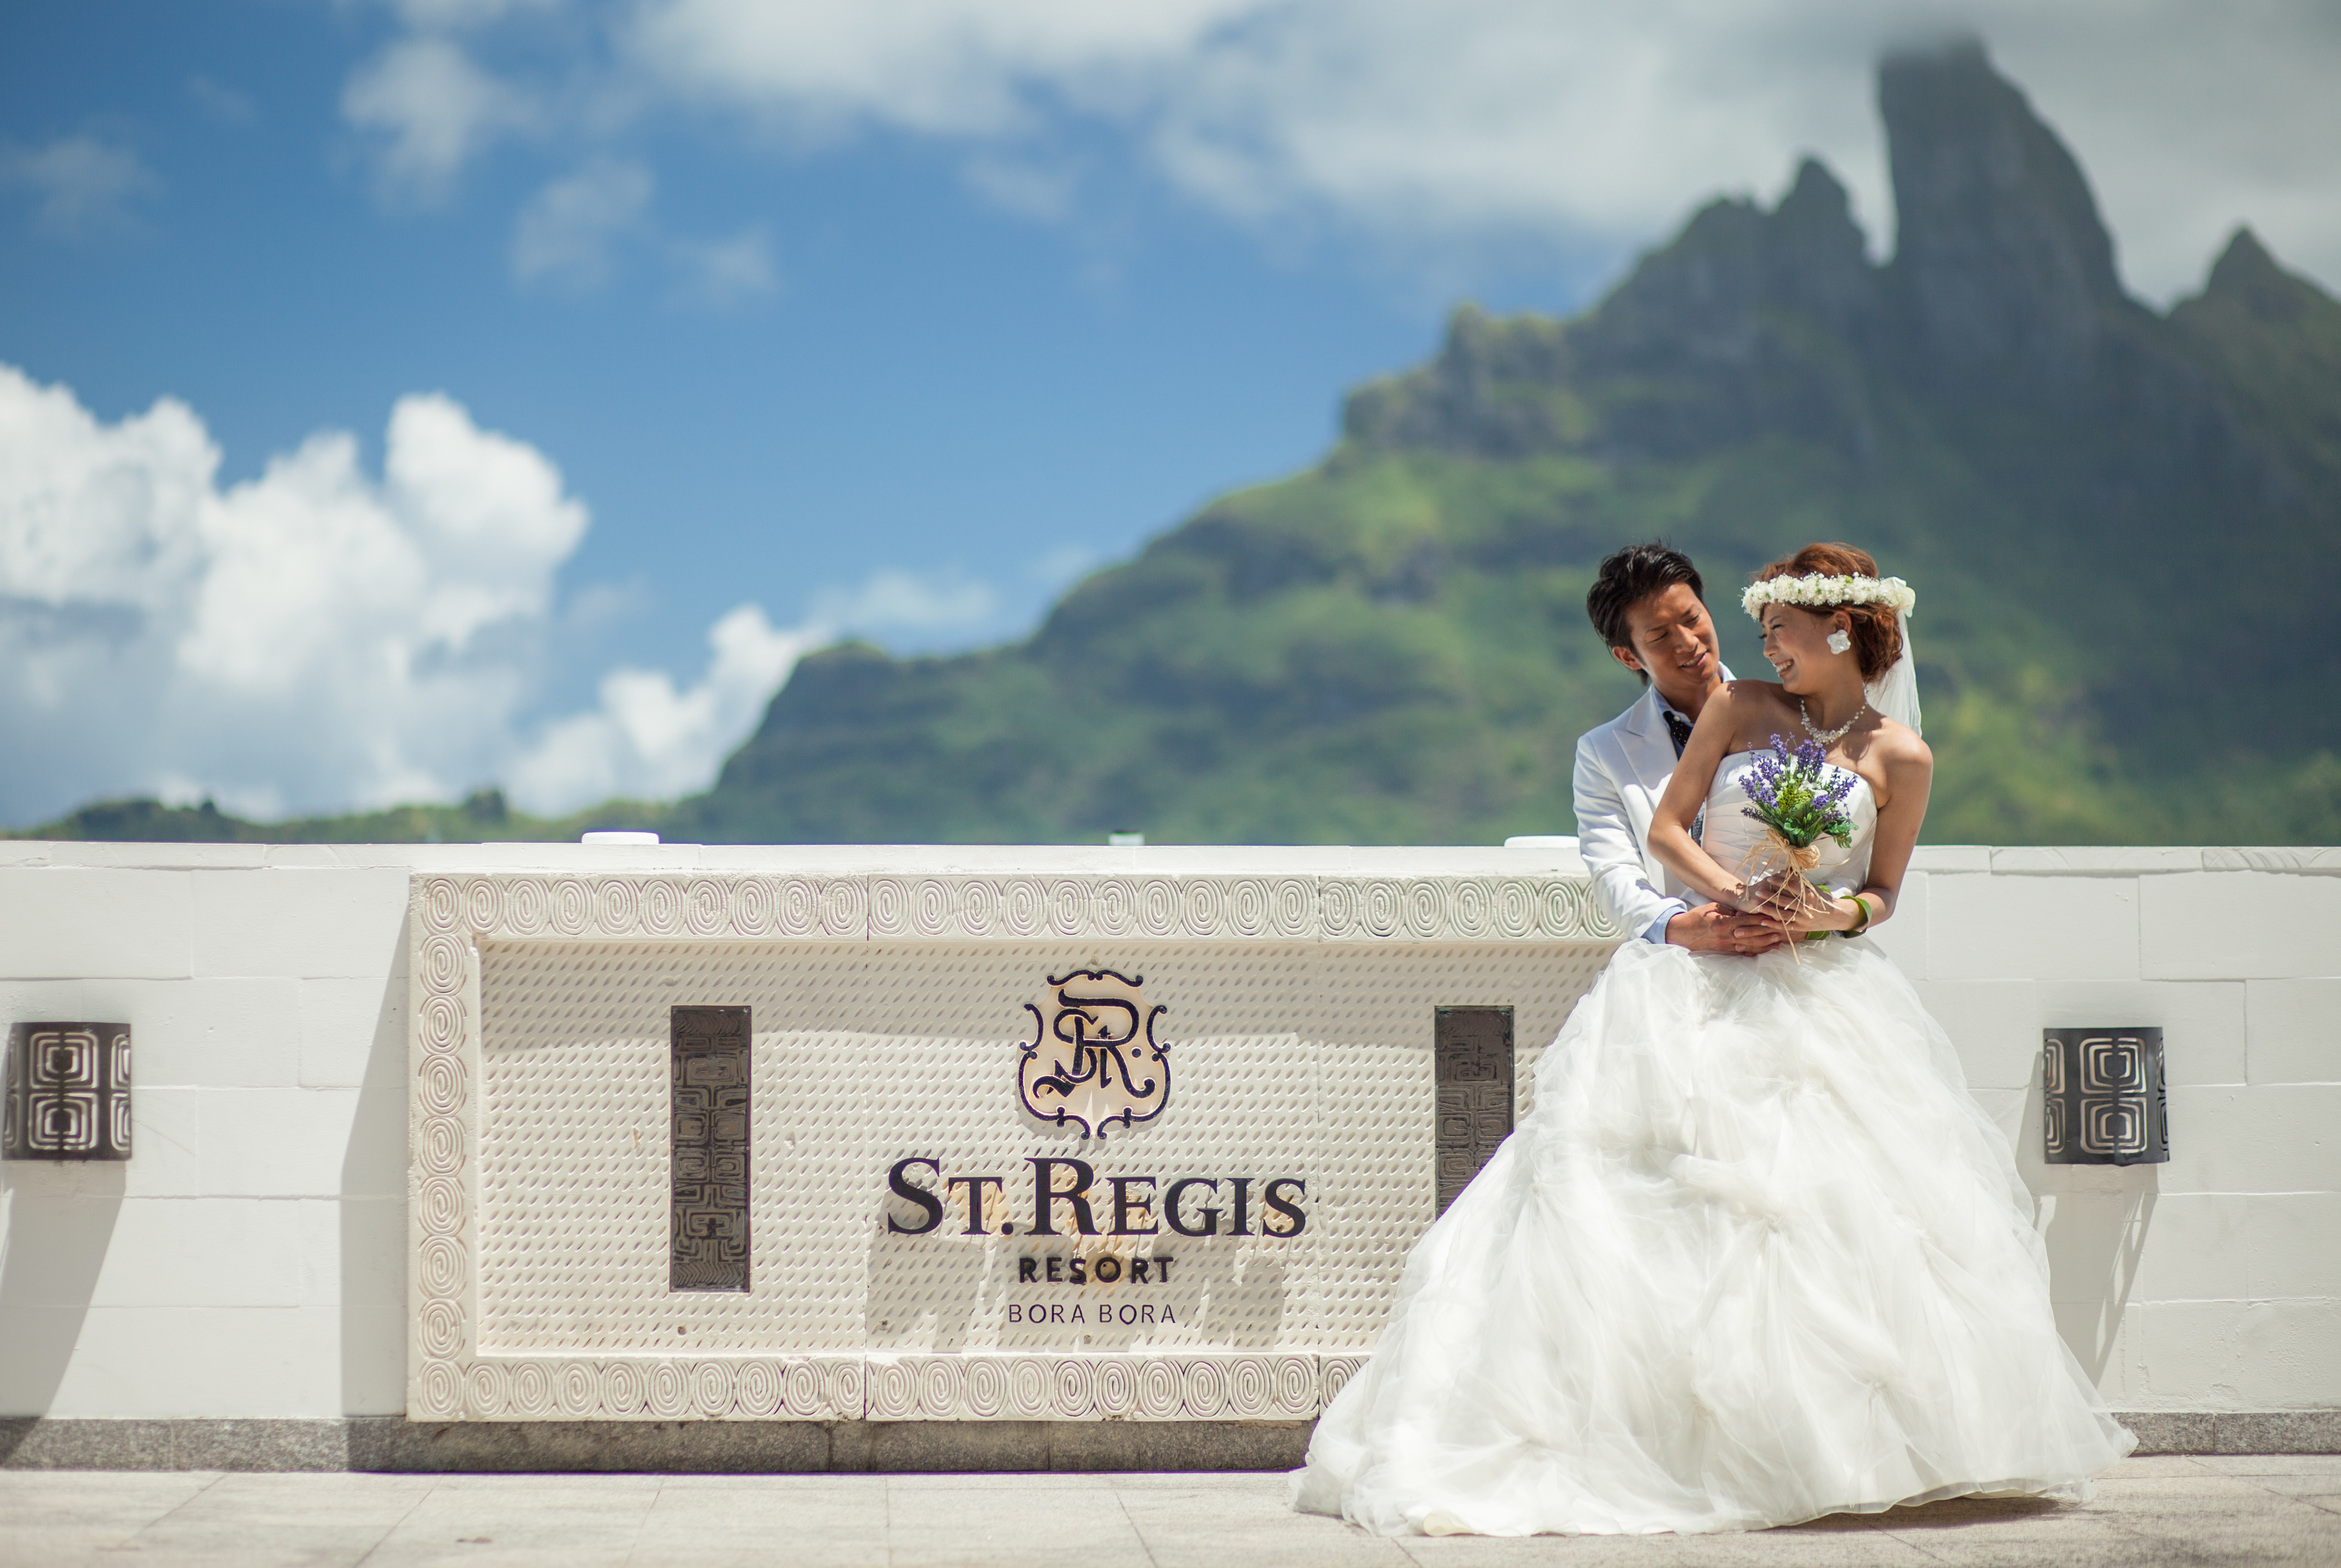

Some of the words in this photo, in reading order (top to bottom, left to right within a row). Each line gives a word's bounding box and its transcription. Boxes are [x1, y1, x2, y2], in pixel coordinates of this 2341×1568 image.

[1019, 1256, 1174, 1284] RESORT
[1009, 1304, 1085, 1324] BORA
[1099, 1304, 1176, 1325] BORA
